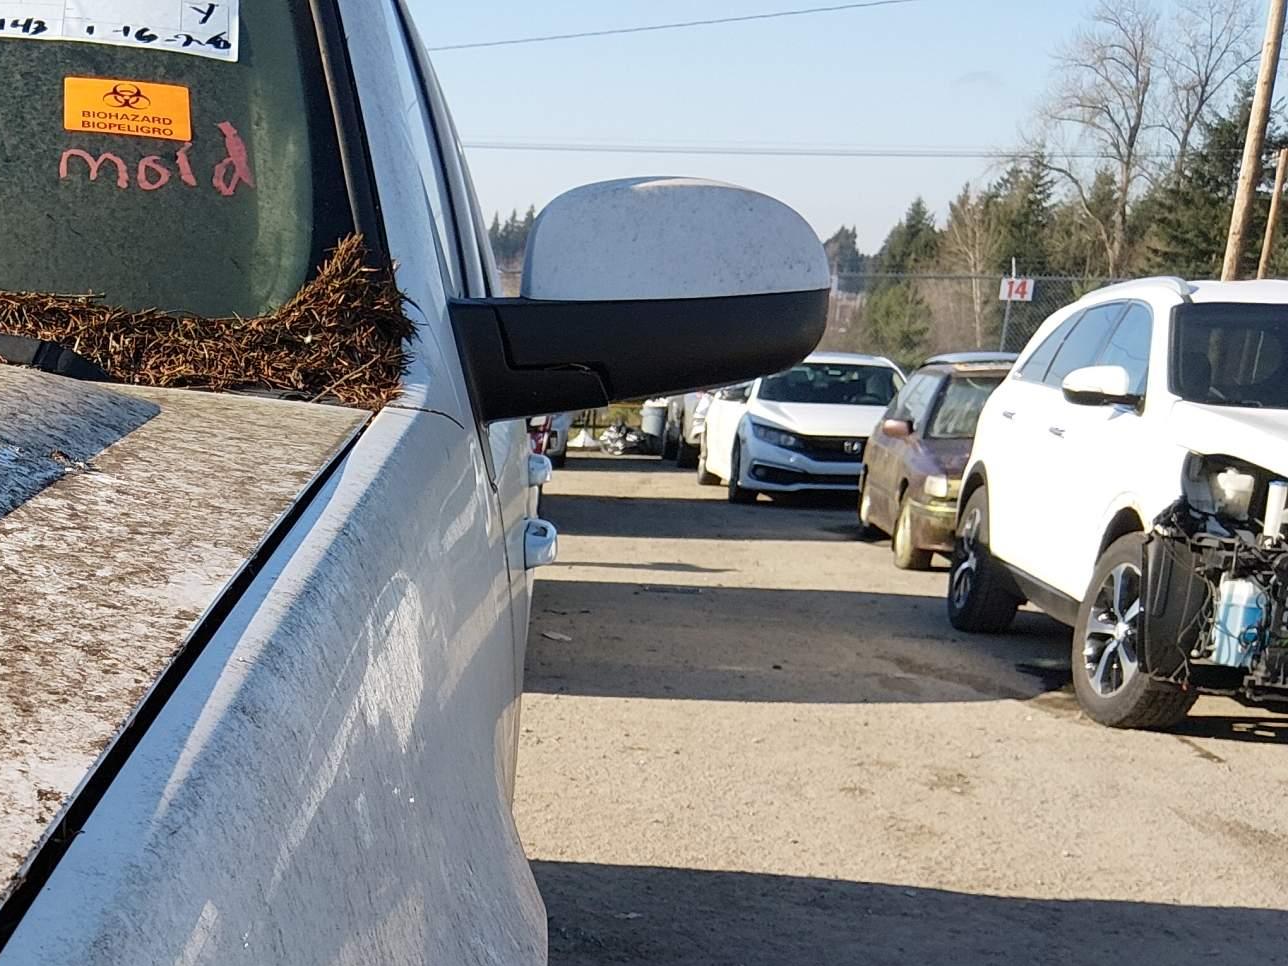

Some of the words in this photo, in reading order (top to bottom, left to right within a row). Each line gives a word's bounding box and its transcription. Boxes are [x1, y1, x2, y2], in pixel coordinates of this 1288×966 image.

[81, 110, 173, 126] BIOHAZARD
[81, 120, 174, 137] BIOPELIGRO
[1007, 280, 1028, 299] 14
